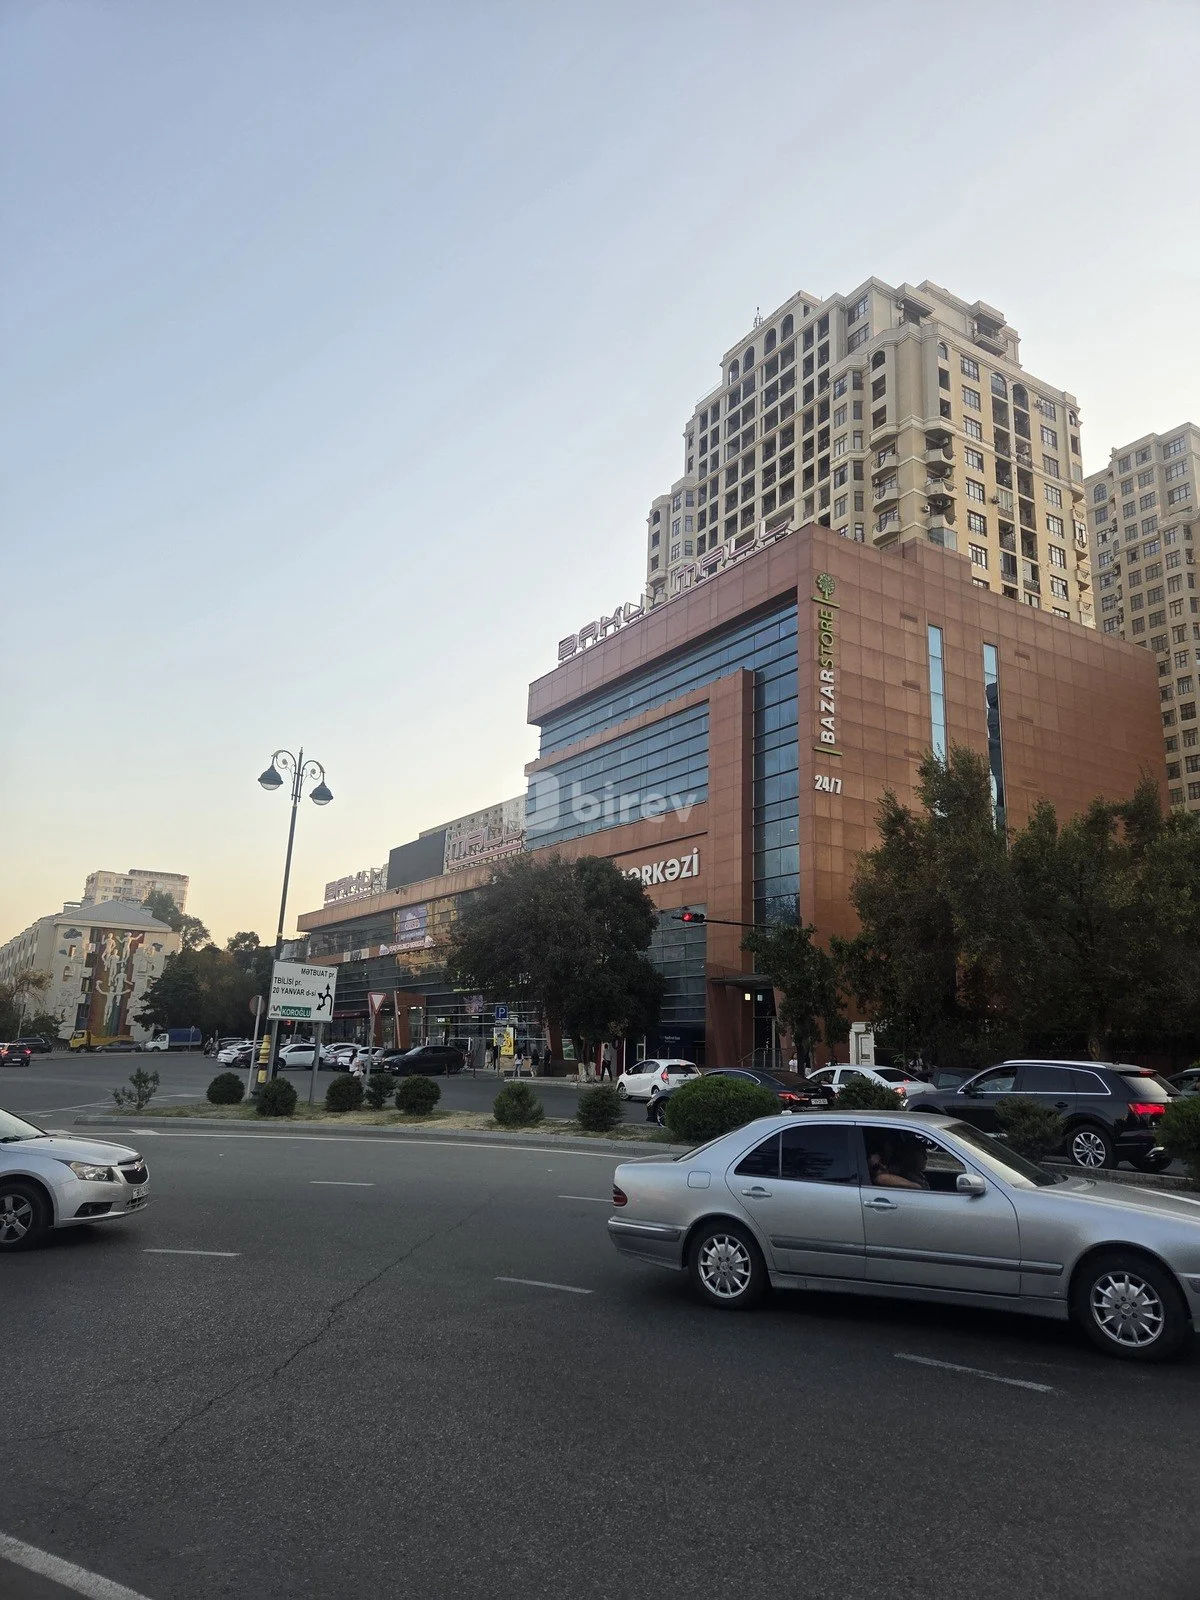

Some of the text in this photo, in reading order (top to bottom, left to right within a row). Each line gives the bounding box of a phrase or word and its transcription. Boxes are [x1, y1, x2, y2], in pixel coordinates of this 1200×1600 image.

[558, 518, 793, 661] BAKU MALL
[818, 608, 836, 745] BAZARSTORE
[814, 774, 842, 794] 24/7
[621, 847, 699, 886] ƏRKƏZİ
[301, 968, 328, 977] MƏTBUAT
[281, 988, 305, 996] YANVAR
[281, 1007, 311, 1017] KOROĞLU
